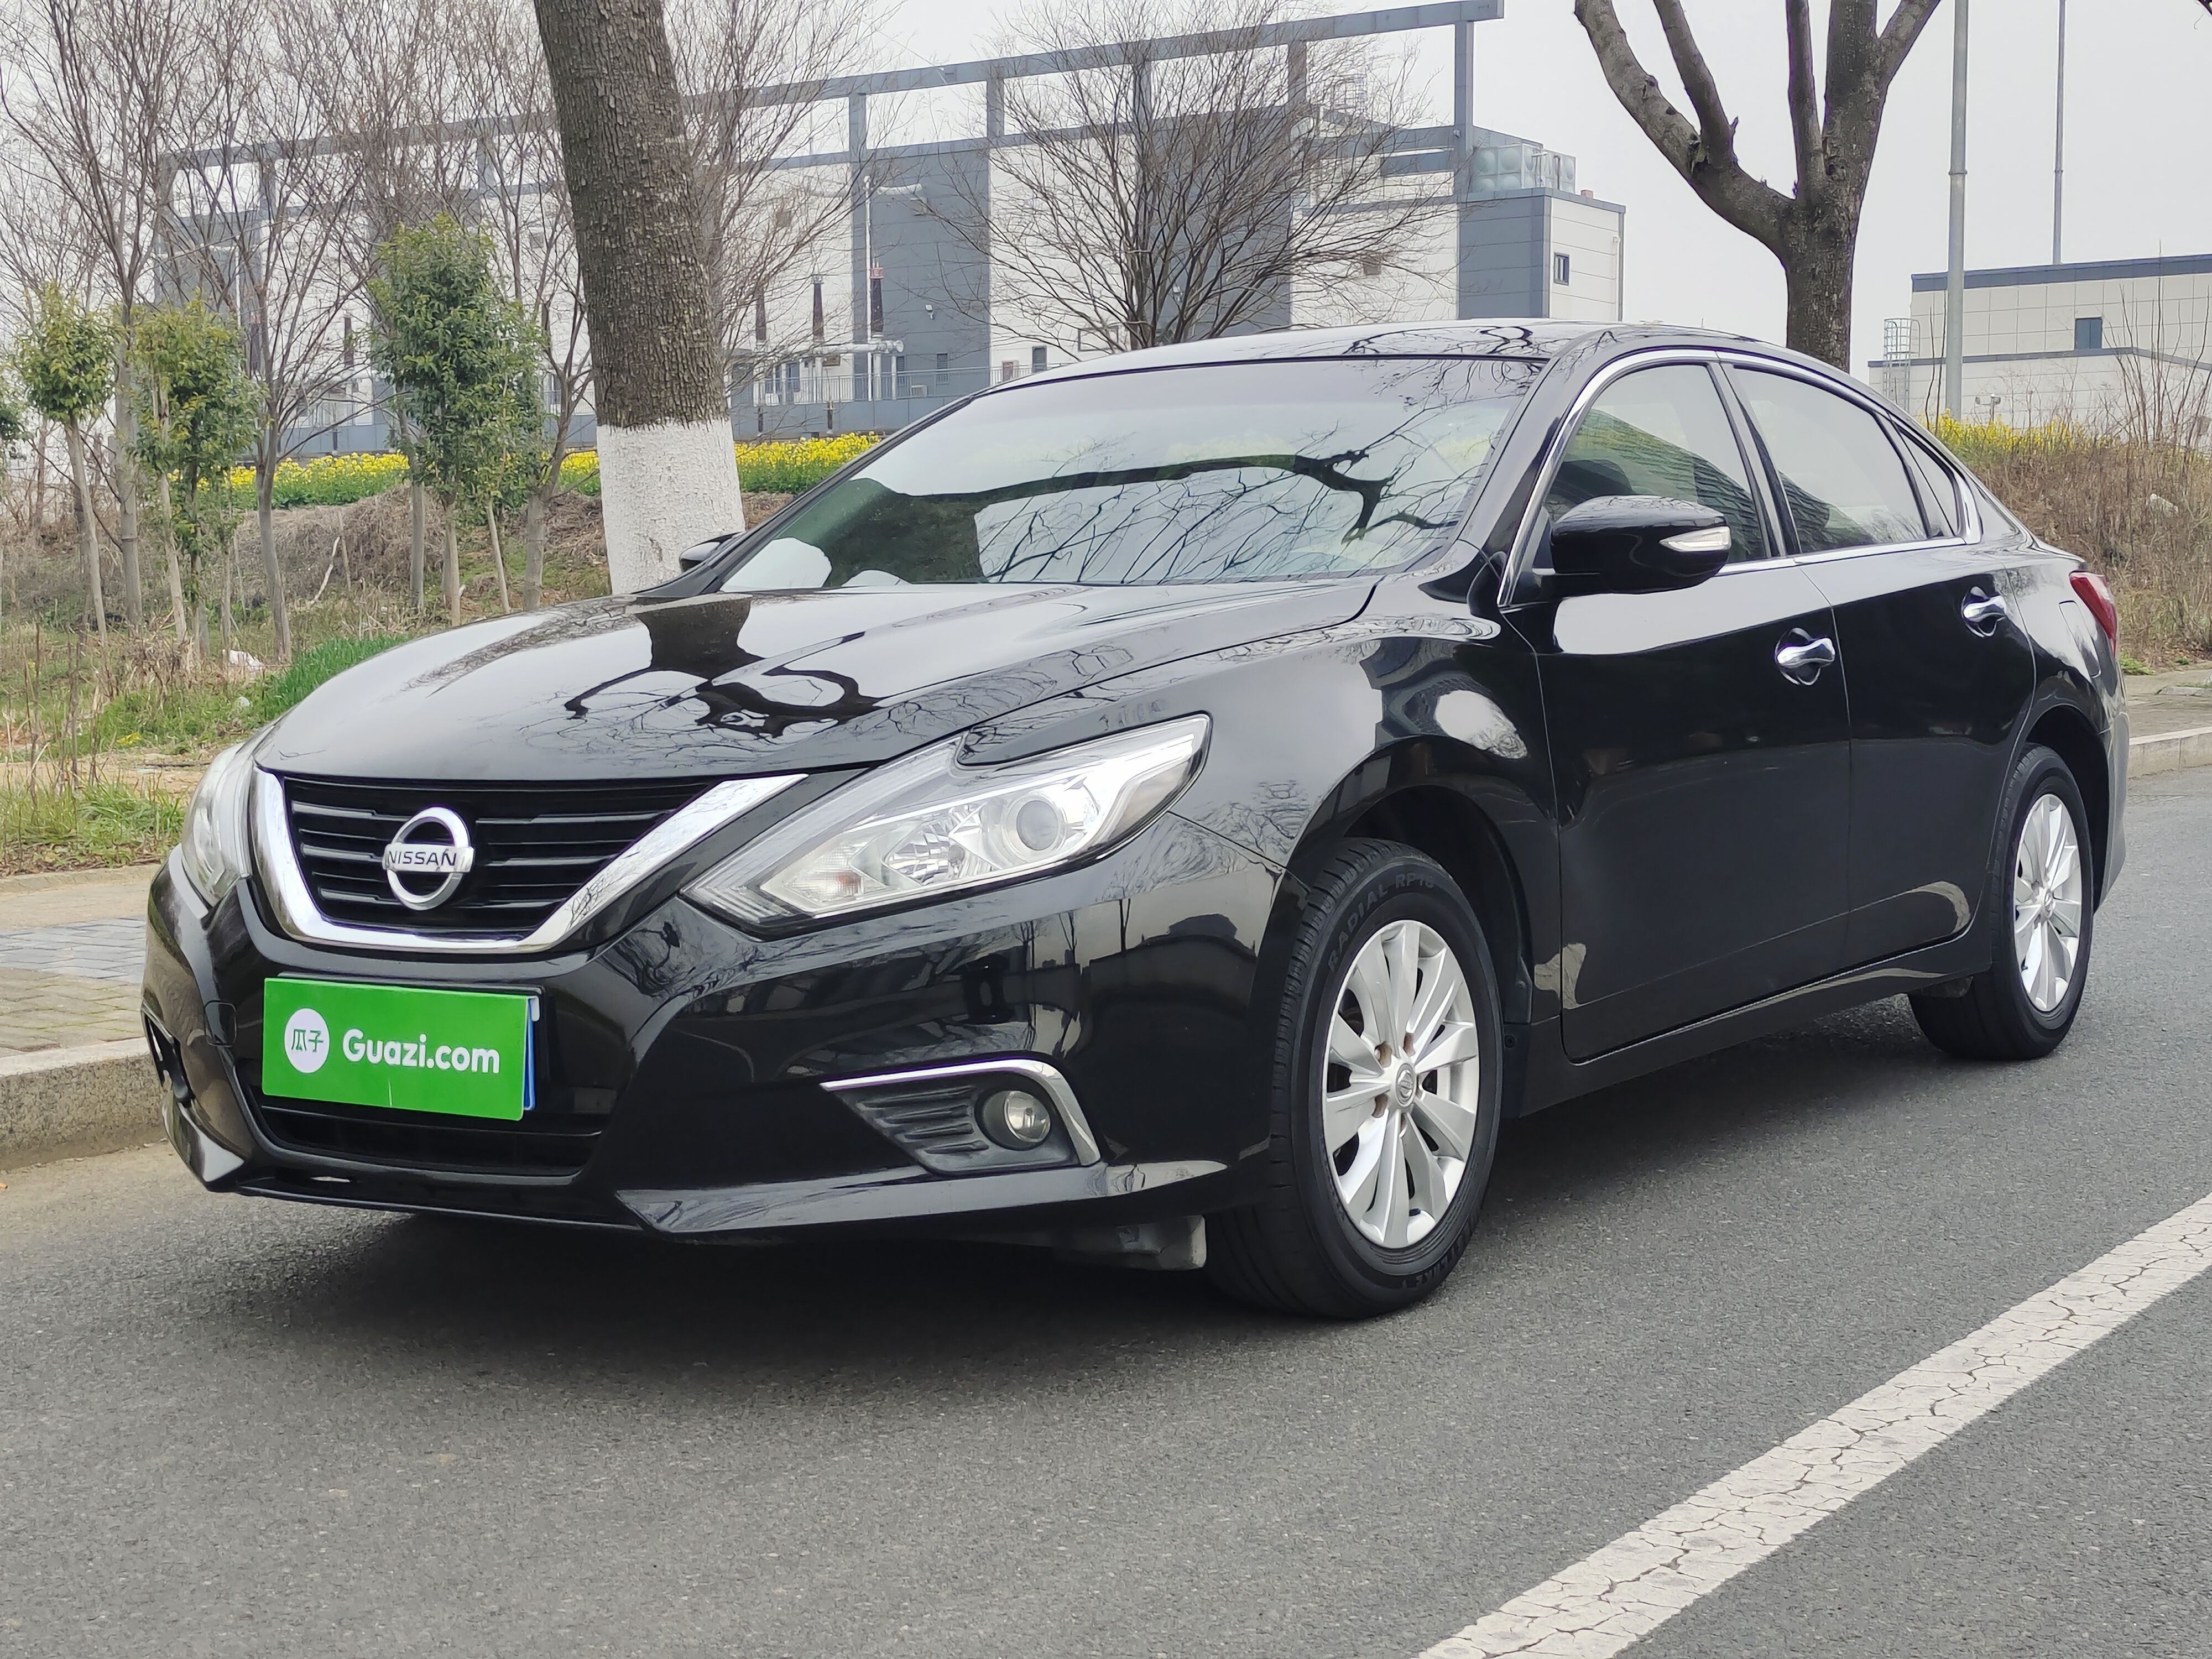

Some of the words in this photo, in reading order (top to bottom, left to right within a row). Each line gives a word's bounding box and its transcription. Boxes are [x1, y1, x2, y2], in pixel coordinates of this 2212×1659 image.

[388, 850, 457, 867] NISSAN
[1328, 884, 1388, 972] RADIAL
[291, 1028, 324, 1052] 瓜子
[342, 1028, 500, 1074] Guazi.com
